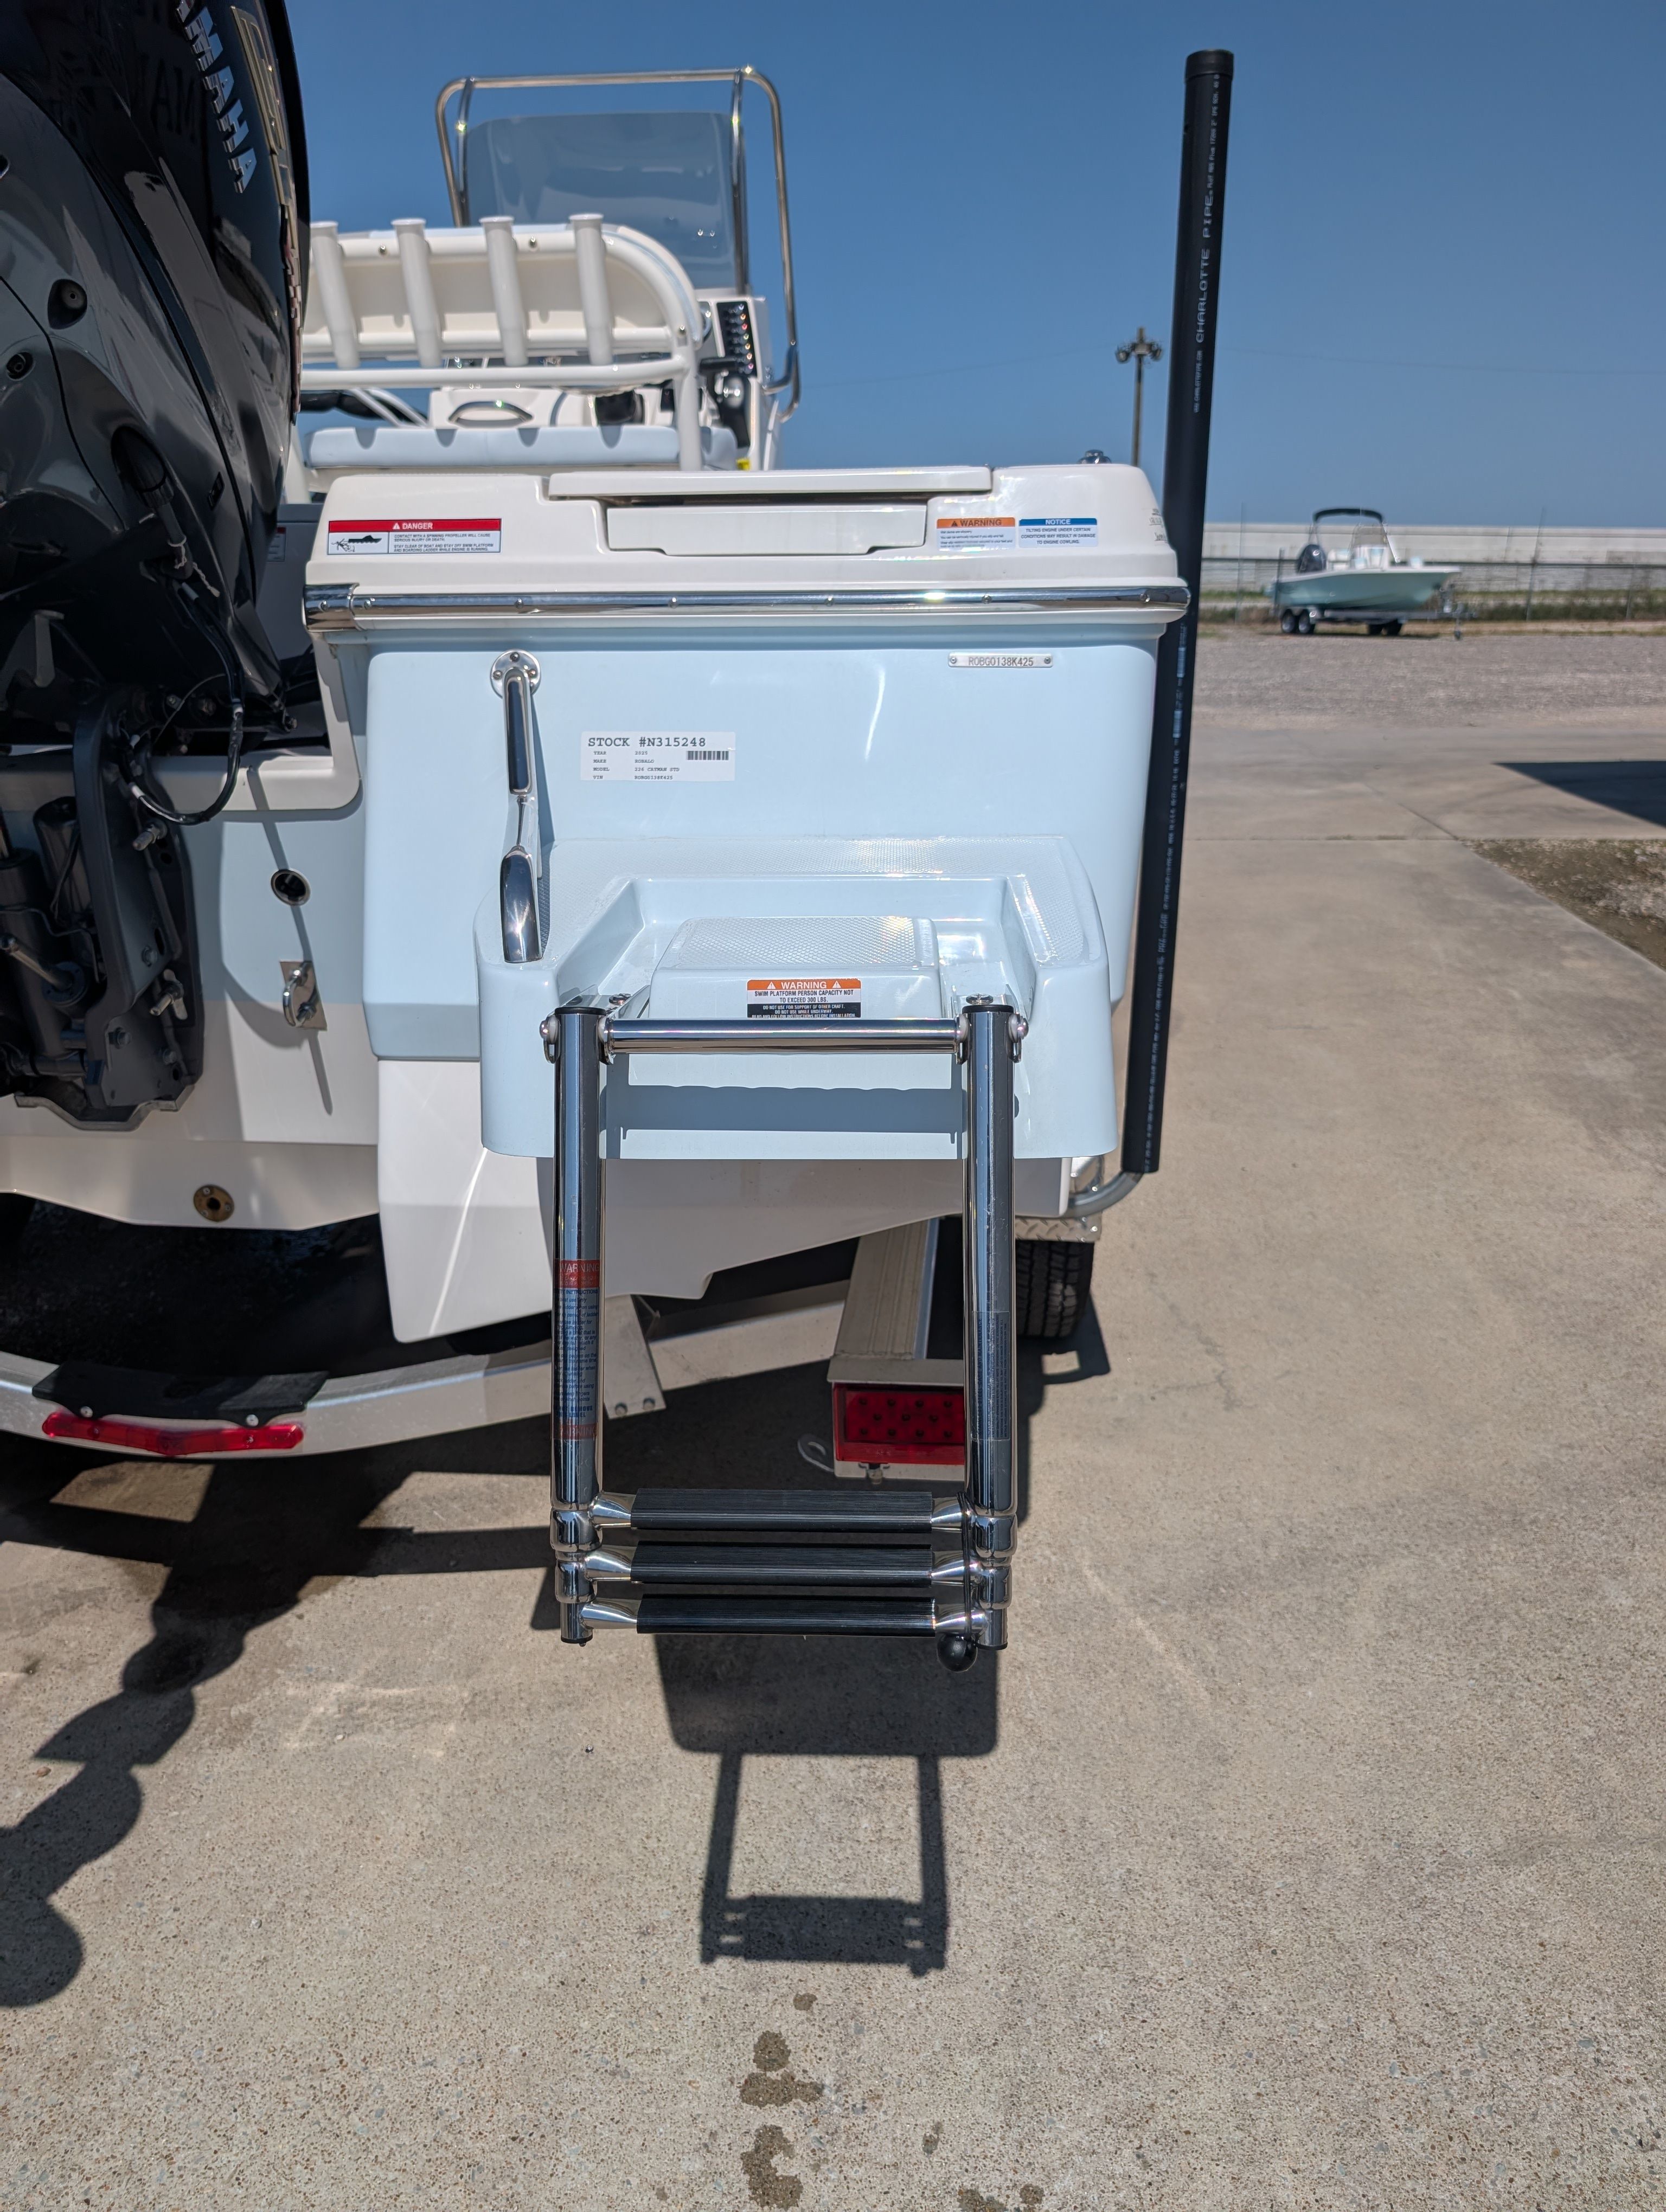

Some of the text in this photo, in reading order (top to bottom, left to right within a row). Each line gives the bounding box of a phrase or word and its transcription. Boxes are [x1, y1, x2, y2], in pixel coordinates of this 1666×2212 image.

[1196, 248, 1210, 343] CHARLOTTE
[588, 737, 706, 747] STOCK #N315248
[781, 981, 827, 989] WARNING
